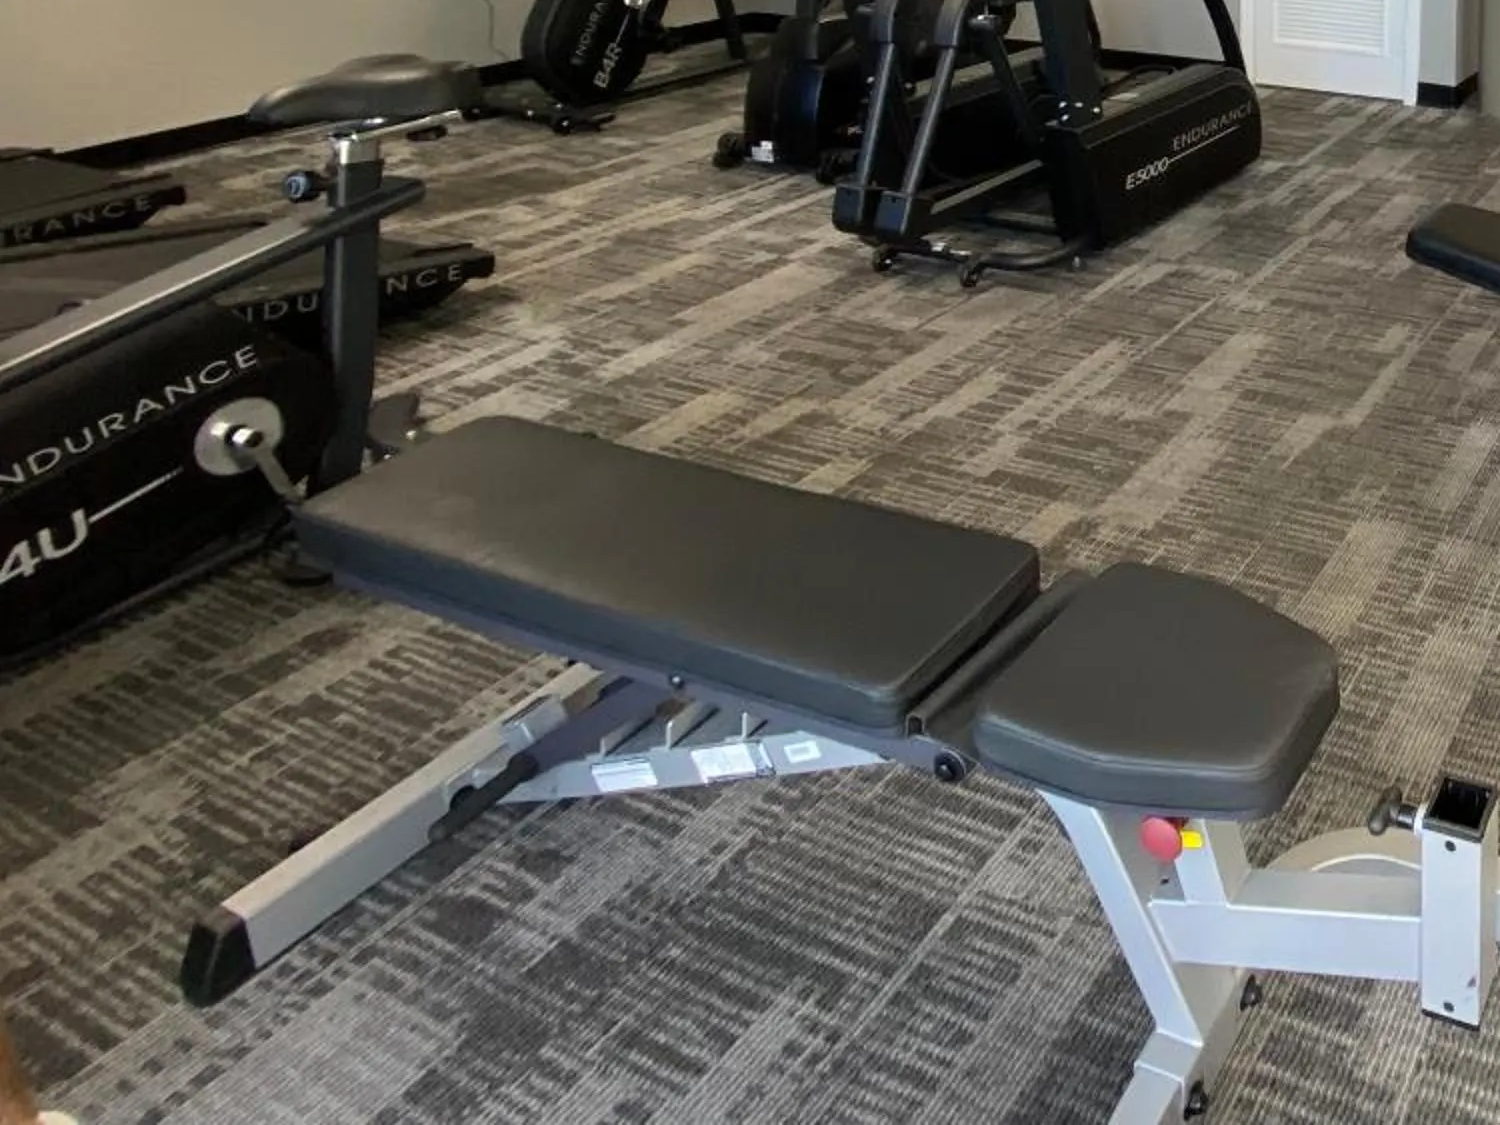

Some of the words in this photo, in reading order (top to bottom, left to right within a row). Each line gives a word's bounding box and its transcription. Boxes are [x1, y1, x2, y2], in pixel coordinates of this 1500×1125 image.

[0, 194, 153, 244] RANCE
[0, 345, 257, 485] NDURANCE
[0, 508, 89, 585] 4U
